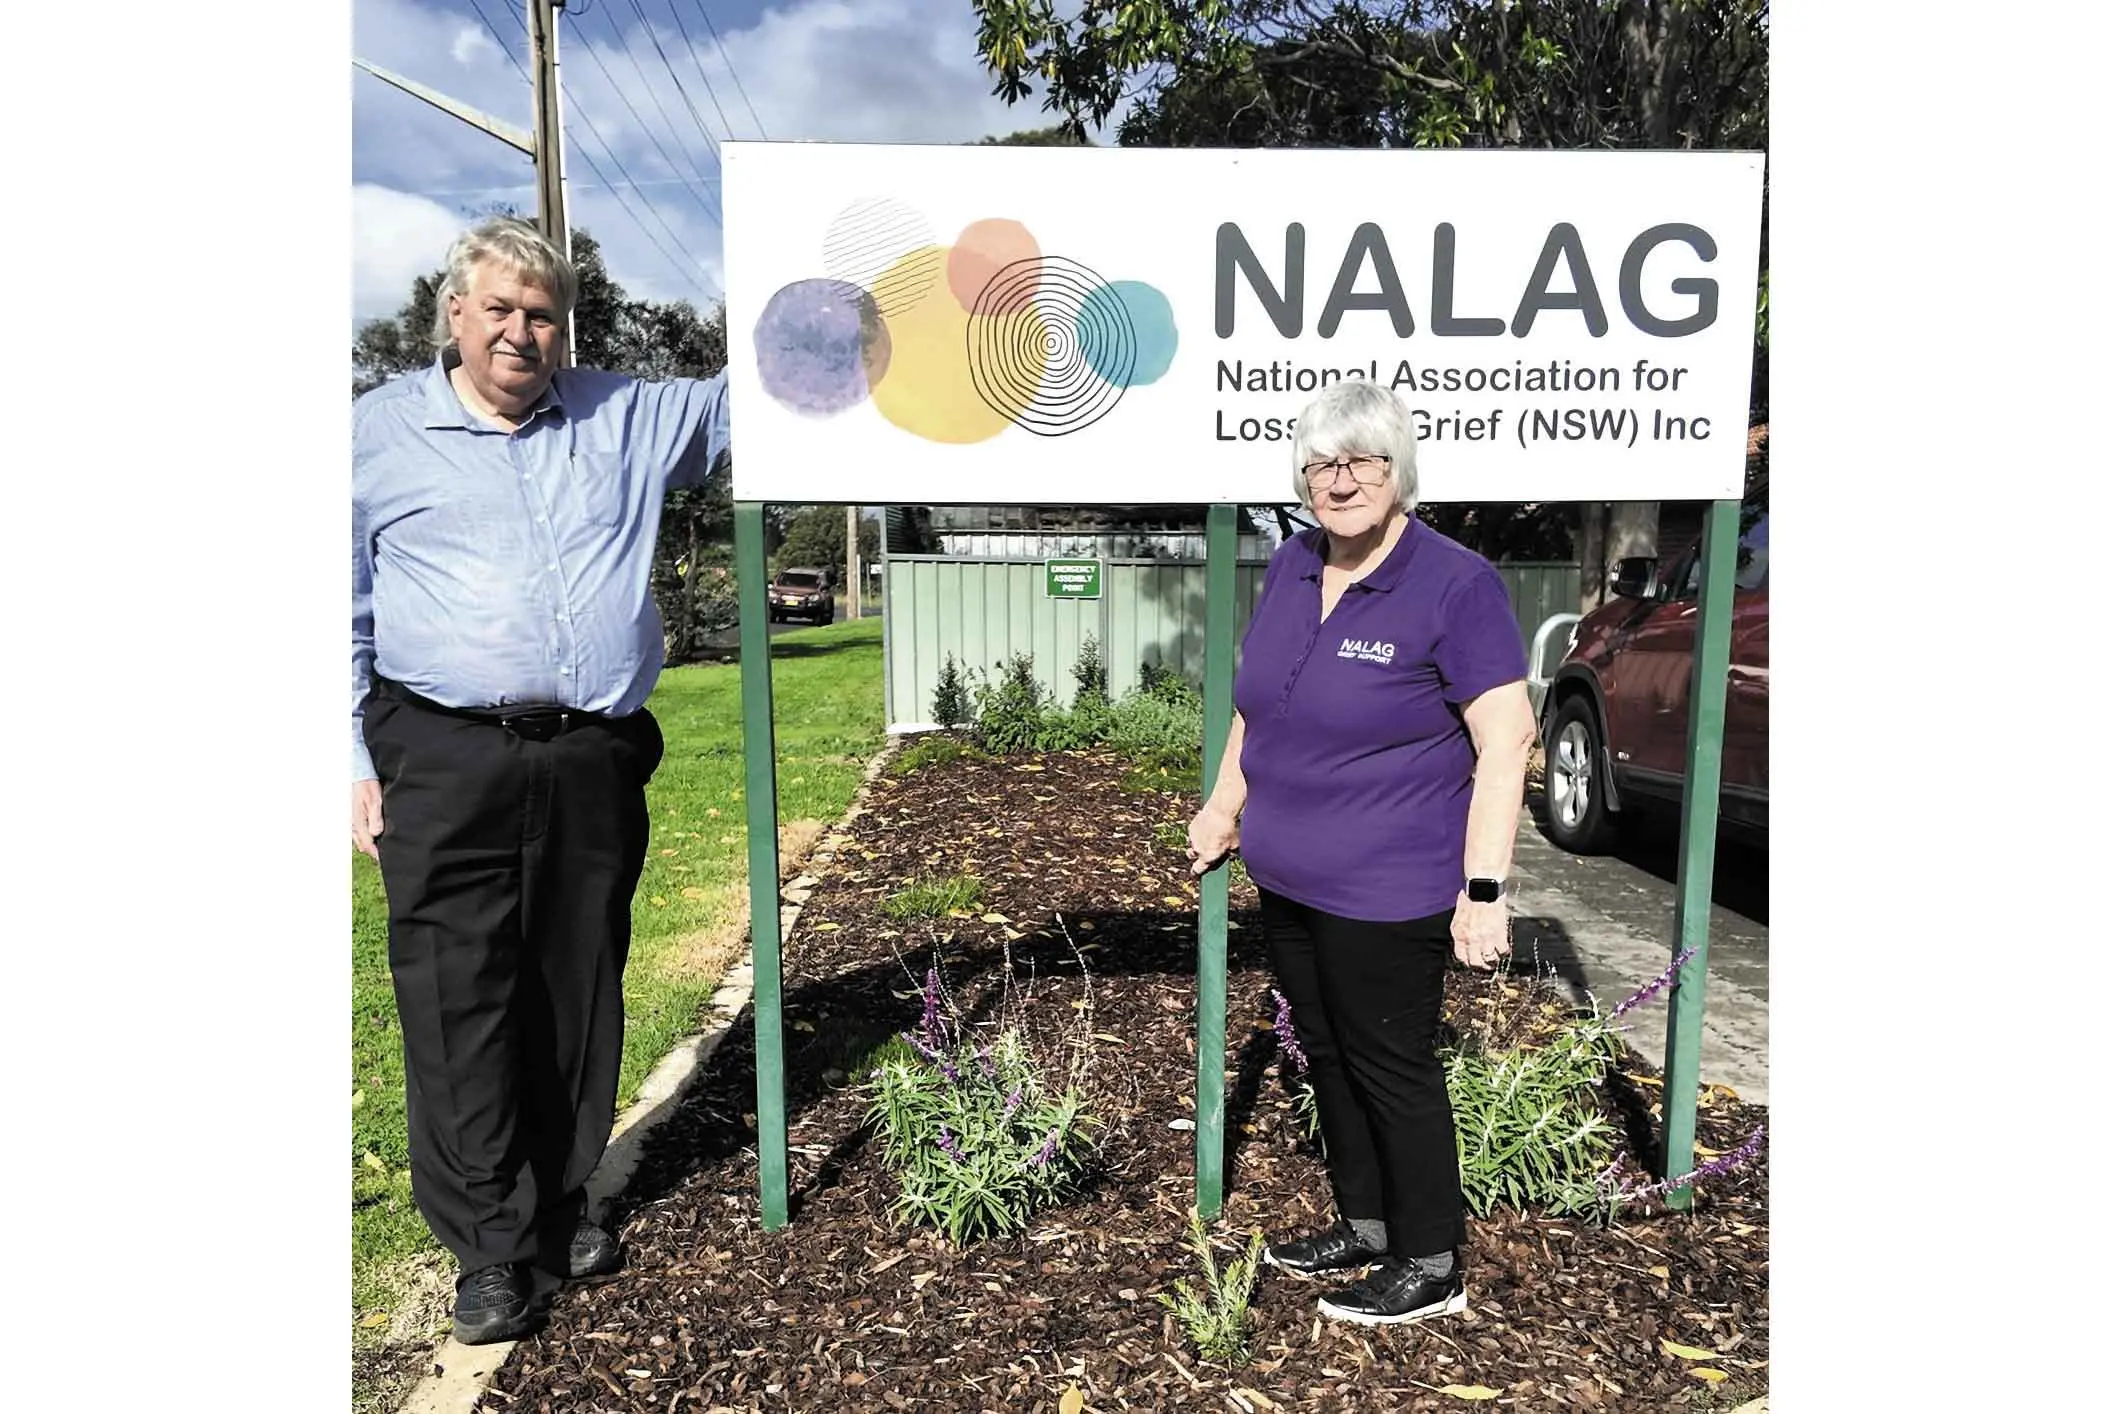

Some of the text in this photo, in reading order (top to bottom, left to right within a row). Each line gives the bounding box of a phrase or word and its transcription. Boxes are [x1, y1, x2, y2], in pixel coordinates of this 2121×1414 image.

[1214, 221, 1720, 339] NALAG
[1391, 359, 1620, 392] Association
[1632, 359, 1689, 392] for
[1411, 409, 1503, 441] Grief
[1517, 408, 1640, 449] (NSW)
[1653, 408, 1711, 441] Inc
[1340, 638, 1395, 657] NALAG
